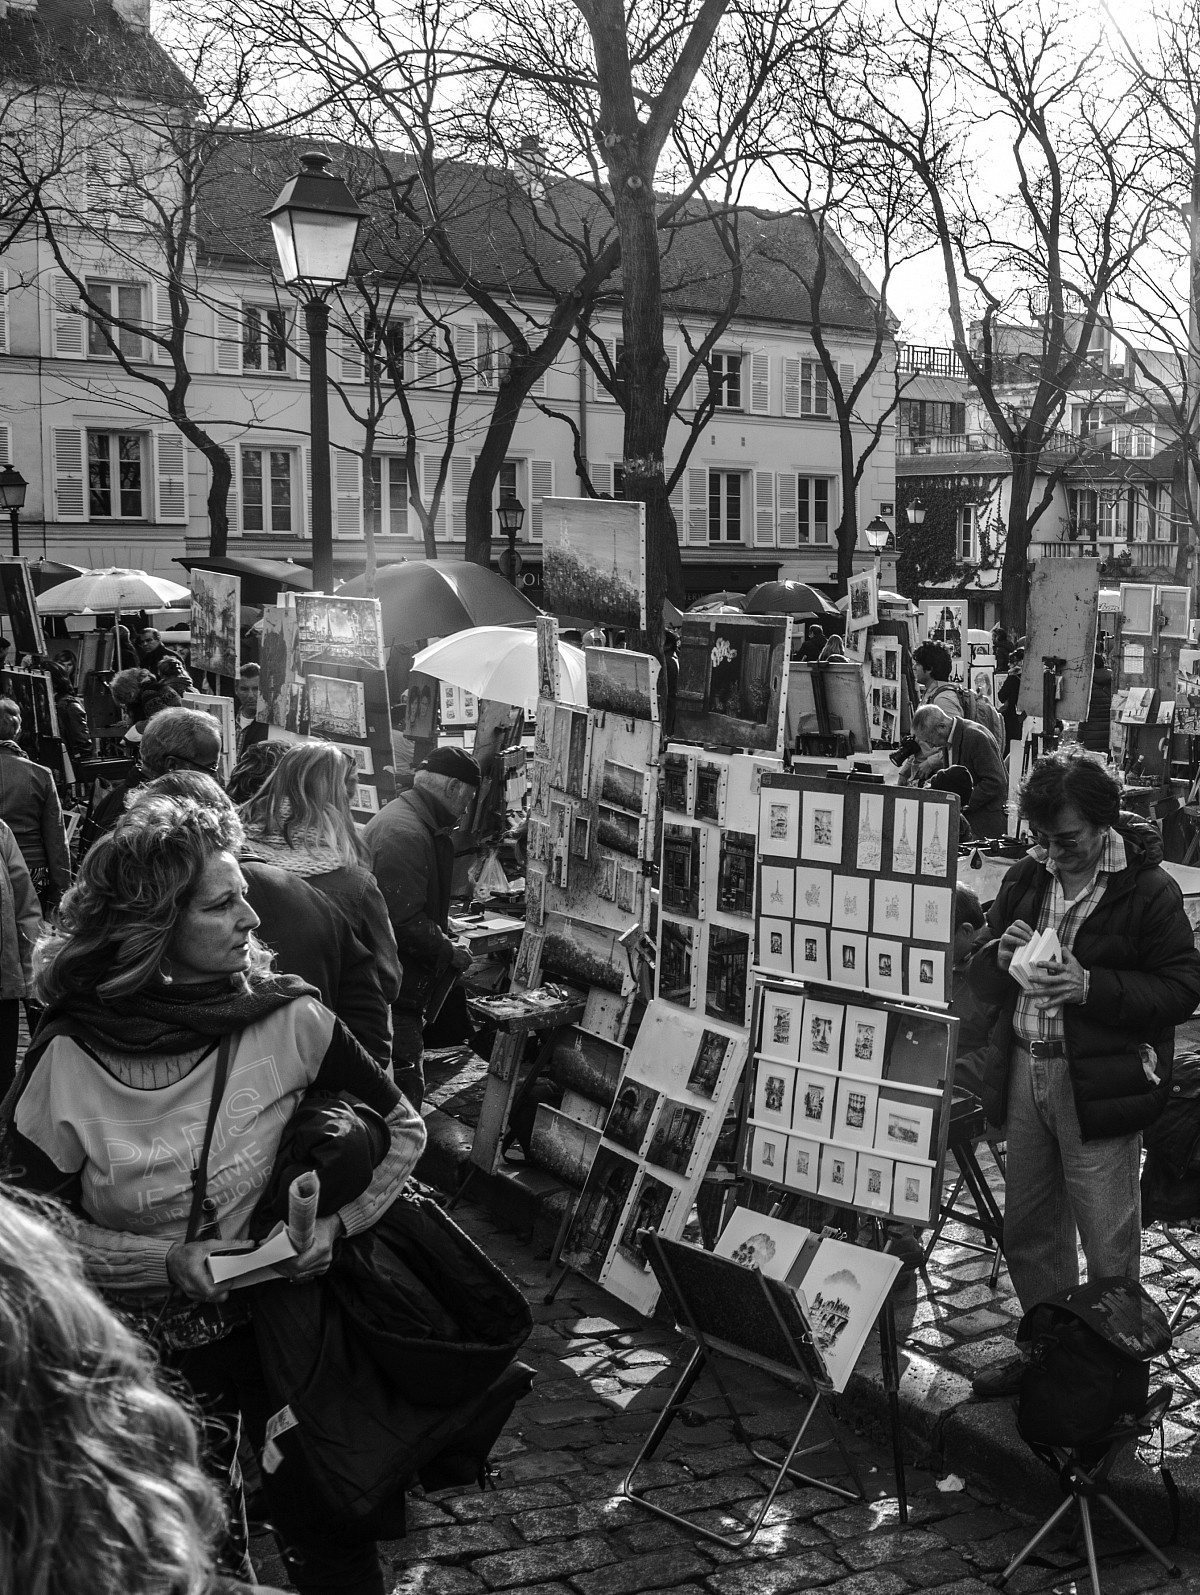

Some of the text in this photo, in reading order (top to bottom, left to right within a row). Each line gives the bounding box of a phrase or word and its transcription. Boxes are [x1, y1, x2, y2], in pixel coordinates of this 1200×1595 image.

[125, 1164, 273, 1227] POUR OUJOUR
[134, 1187, 168, 1214] JE
